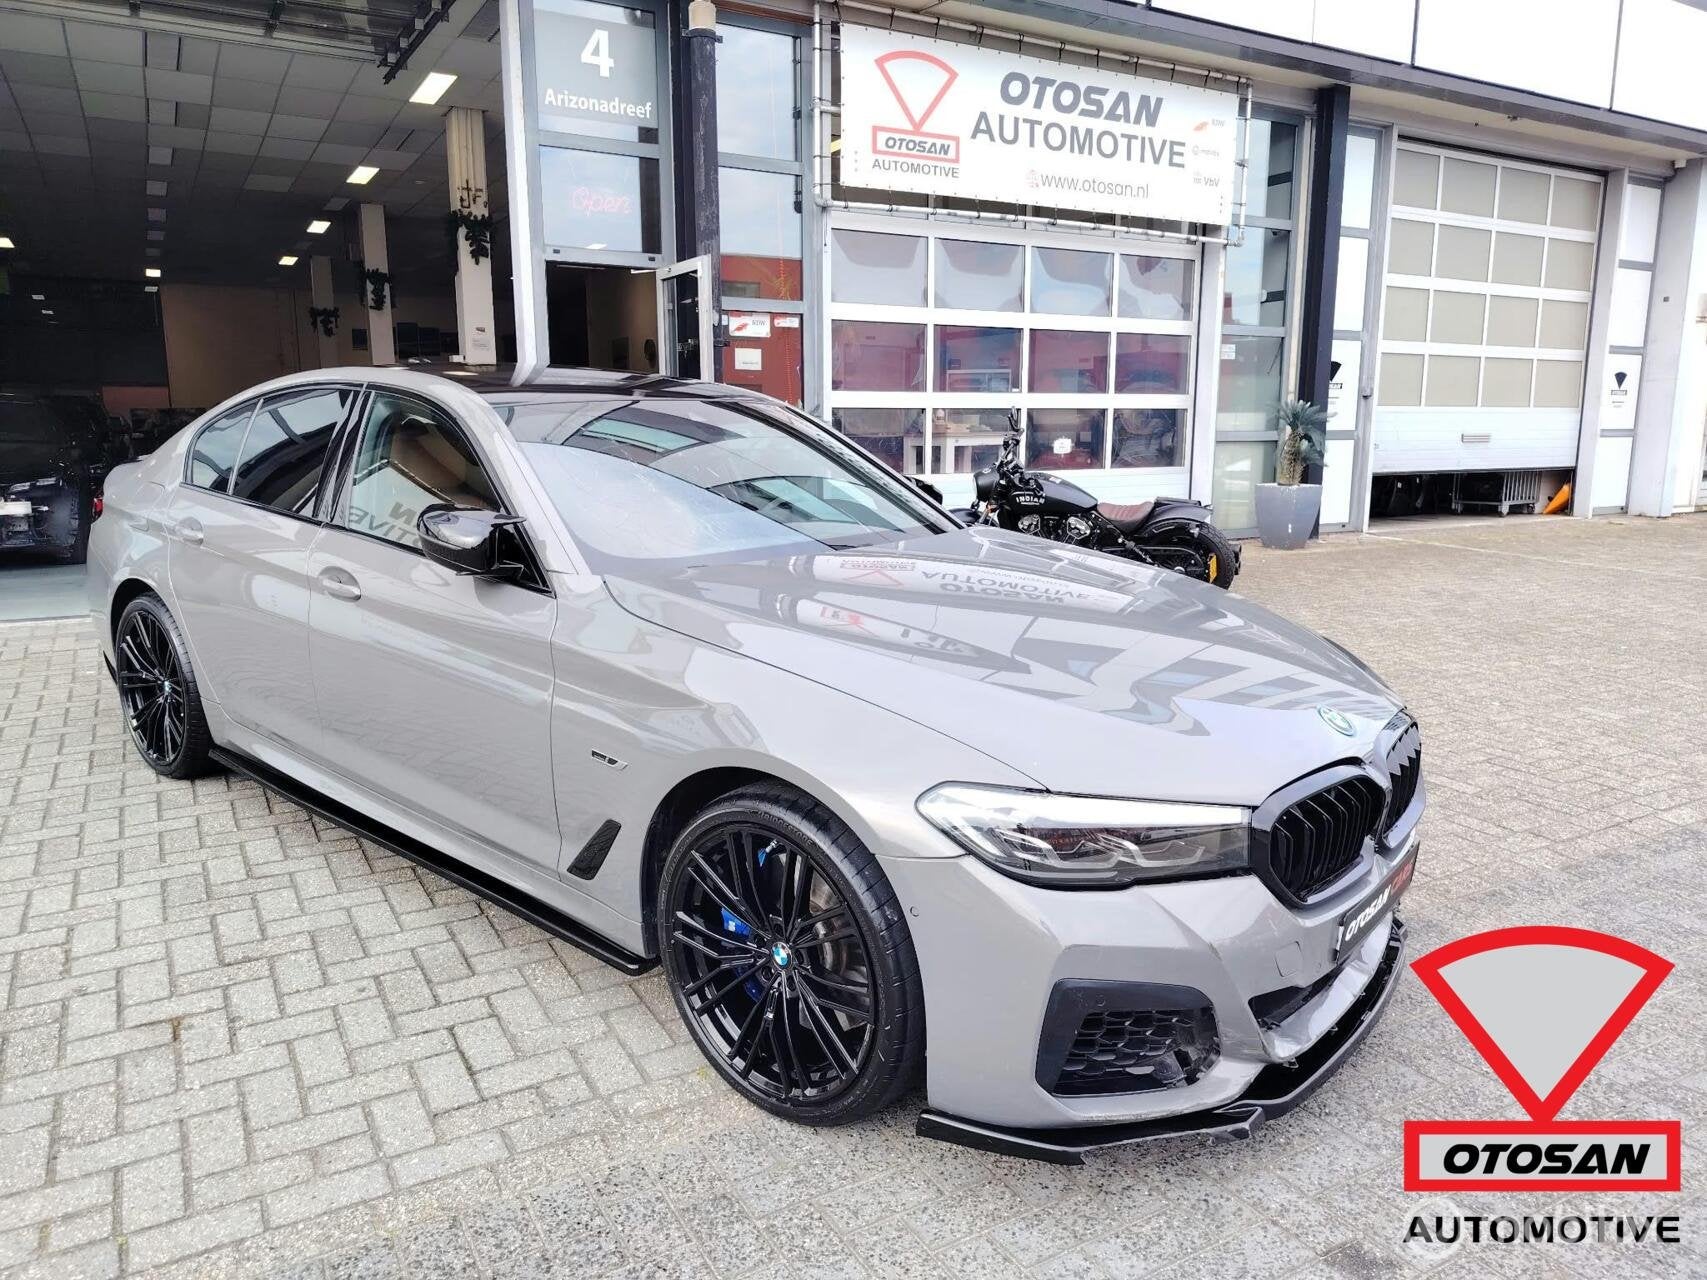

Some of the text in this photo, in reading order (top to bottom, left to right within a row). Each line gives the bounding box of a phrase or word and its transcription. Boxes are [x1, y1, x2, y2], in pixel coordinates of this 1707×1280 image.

[580, 28, 615, 78] 4
[544, 87, 652, 119] Arizonadreef
[1000, 71, 1164, 128] OTOSAN
[884, 136, 951, 156] OTOSAN
[970, 111, 1186, 169] AUTOMOTIVE
[872, 158, 960, 179] AUTOMOTIVE
[1039, 173, 1150, 199] www.otosan.nl
[1344, 883, 1392, 942] OTOSAN
